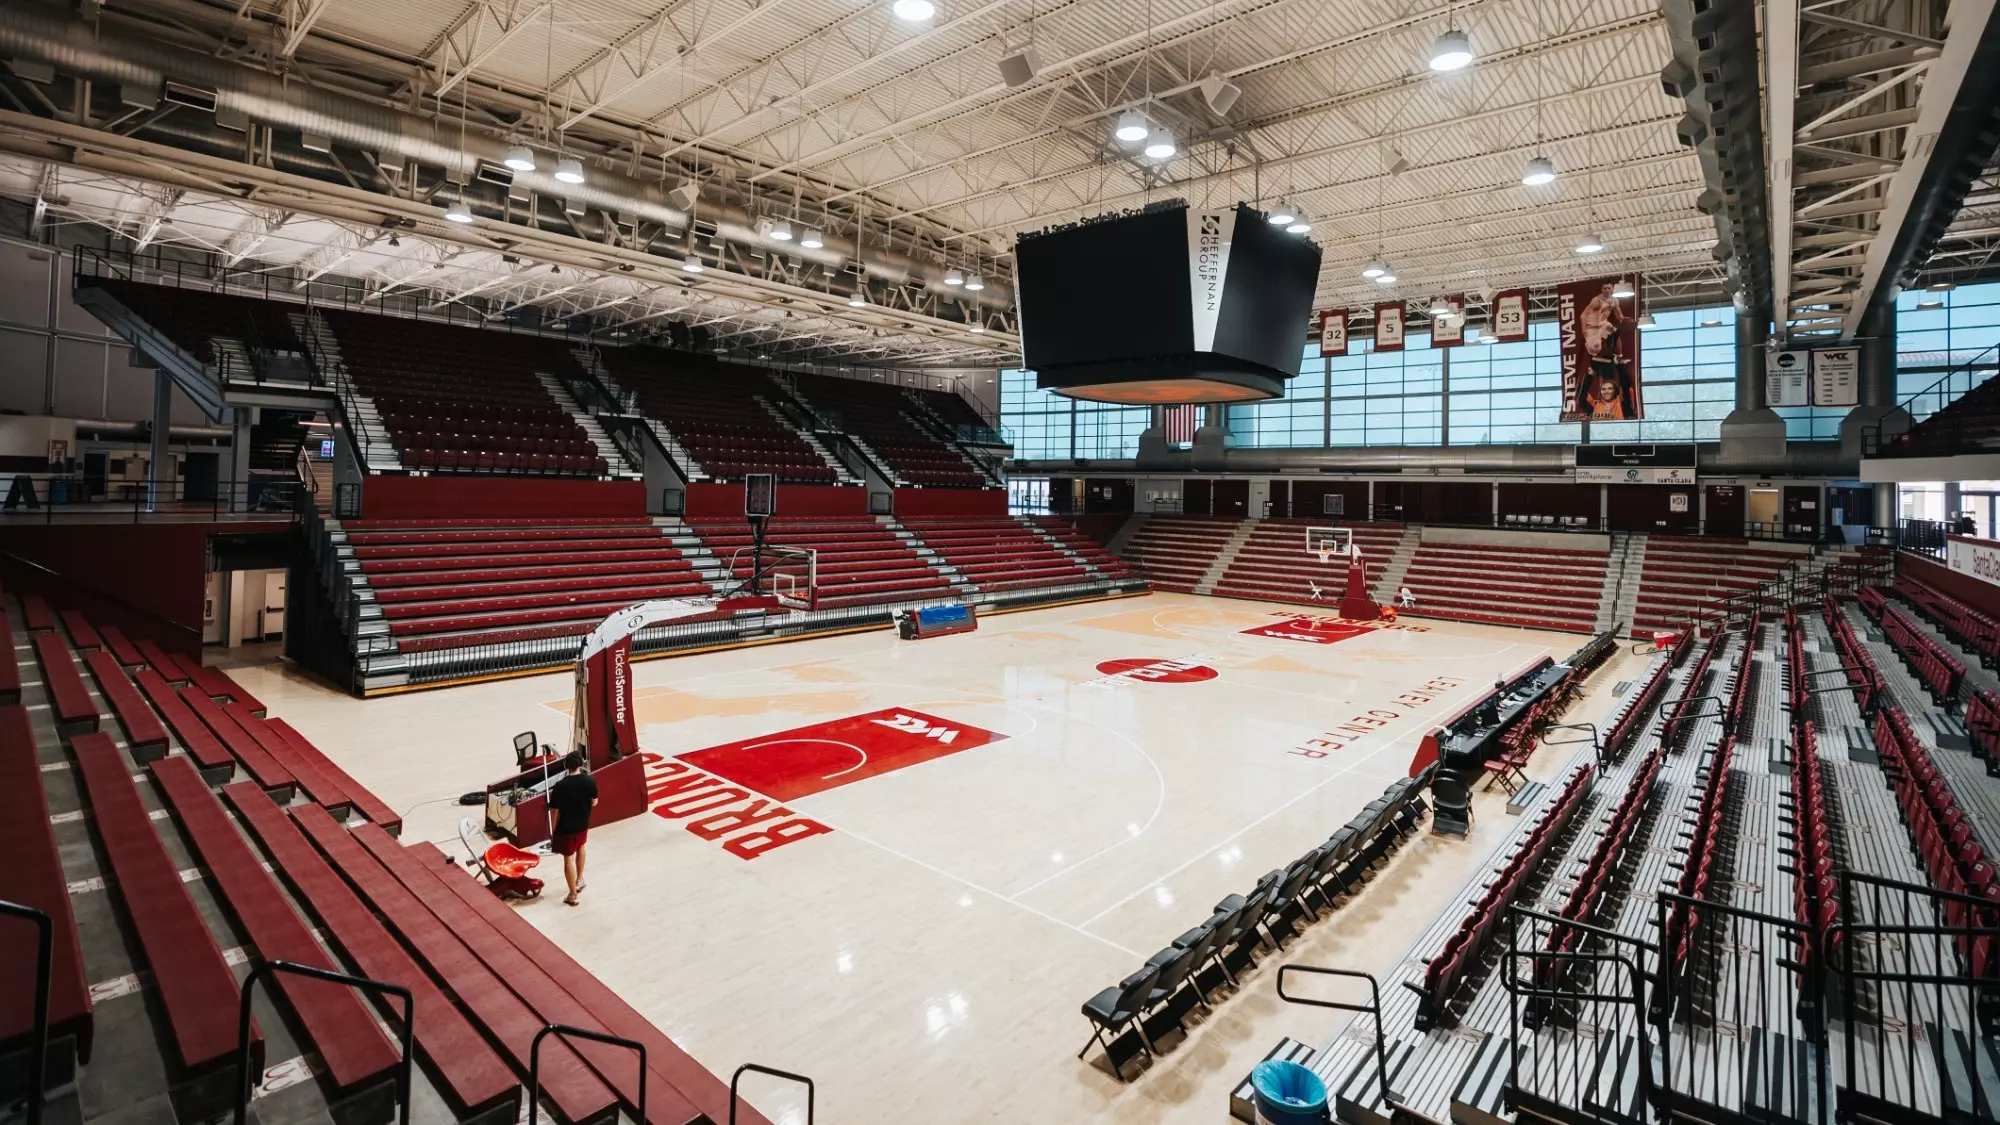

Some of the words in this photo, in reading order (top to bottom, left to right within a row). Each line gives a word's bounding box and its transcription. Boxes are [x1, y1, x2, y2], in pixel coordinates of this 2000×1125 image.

[1198, 236, 1210, 281] GROUP
[1207, 236, 1220, 311] HEFFERNAN
[1326, 330, 1341, 340] 32
[1386, 323, 1394, 333] 5
[1501, 312, 1520, 323] 53
[1560, 293, 1577, 348] NASH
[1824, 352, 1849, 360] WCC
[1563, 353, 1577, 413] STEVE
[615, 647, 627, 725] TicketSmarter
[1391, 676, 1466, 708] LEAVEY
[1287, 710, 1400, 759] CENTER
[642, 753, 835, 860] BRONC
